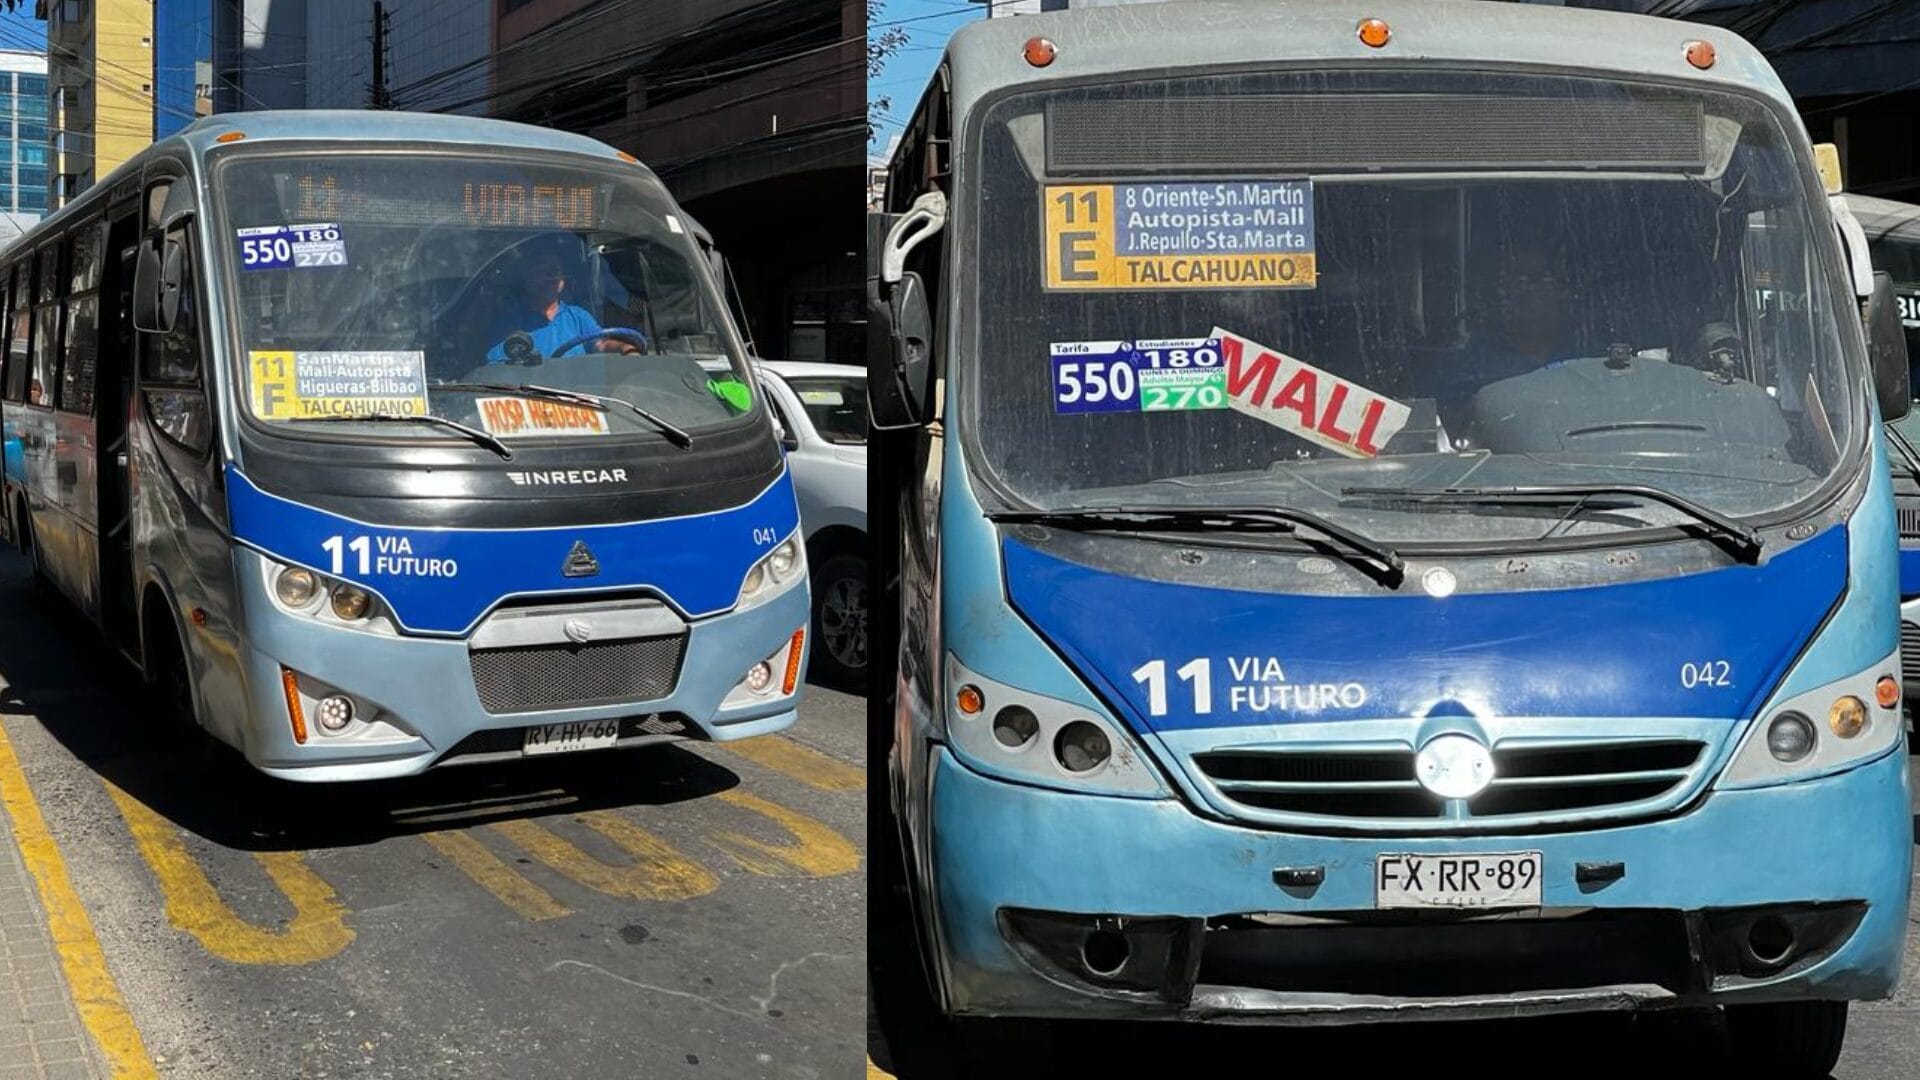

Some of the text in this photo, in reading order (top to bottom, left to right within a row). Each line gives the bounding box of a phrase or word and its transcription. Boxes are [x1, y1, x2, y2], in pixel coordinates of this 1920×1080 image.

[1056, 191, 1098, 224] 11
[1126, 187, 1136, 208] 8
[1127, 207, 1305, 235] Autopista-Mall
[294, 229, 339, 242] 180
[243, 238, 290, 264] 550
[297, 251, 343, 266] 270
[1059, 231, 1098, 282] E
[1127, 257, 1297, 284] TALCAHUANO
[1055, 344, 1090, 354] Tarifa
[1138, 340, 1196, 348] Estudiantes
[256, 357, 284, 377] 11
[1144, 348, 1218, 368] 180
[299, 364, 411, 381] Mall-Autopista
[1058, 361, 1135, 403] 550
[262, 383, 285, 416] F
[301, 379, 417, 397] Higueras-Bilbao
[1146, 386, 1222, 409] 270
[1222, 335, 1386, 458] MALL
[302, 399, 414, 416] TALCAHUANO
[753, 527, 777, 546] 041
[321, 535, 413, 575] 11 VIA
[376, 556, 458, 577] FUTURO
[1681, 660, 1730, 689] 042
[1132, 657, 1285, 716] 11 VIA
[1230, 682, 1367, 713] FUTURO
